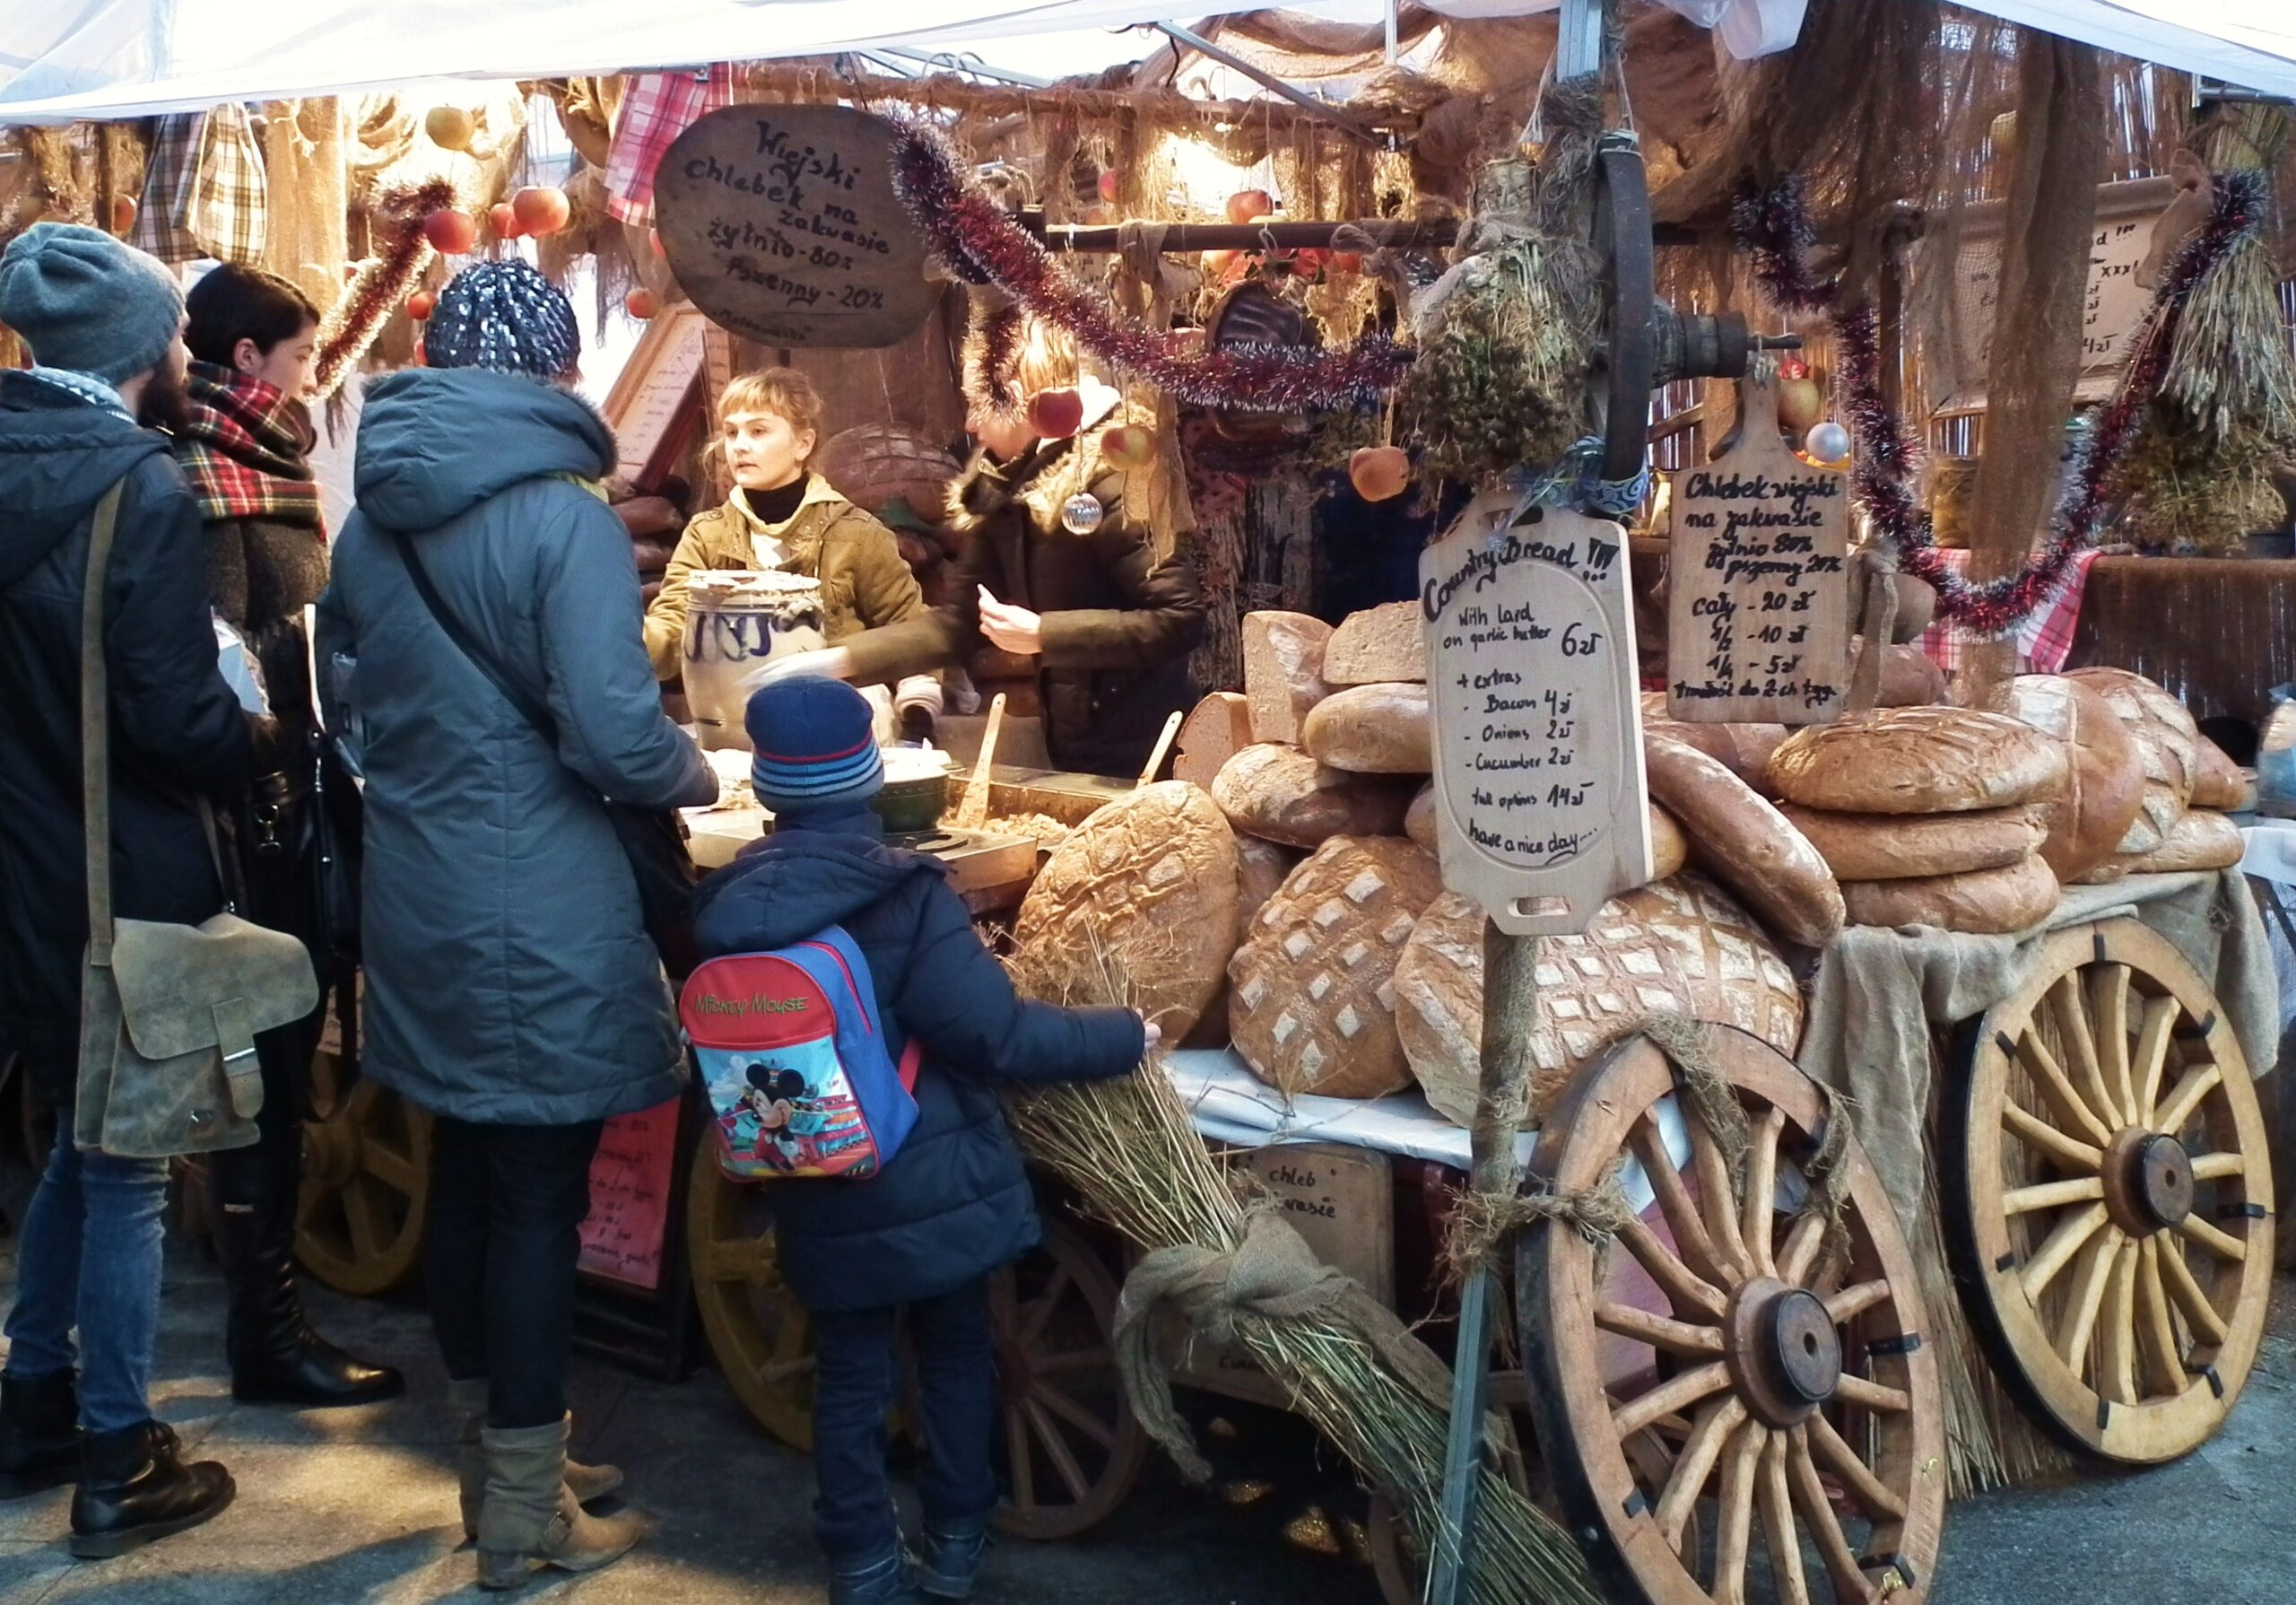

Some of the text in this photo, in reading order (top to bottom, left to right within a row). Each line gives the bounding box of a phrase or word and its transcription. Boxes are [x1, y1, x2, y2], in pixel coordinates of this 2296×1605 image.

[823, 203, 858, 225] na
[778, 209, 890, 255] zakwasie
[839, 284, 884, 310] 20%
[1685, 512, 1716, 528] na
[1423, 548, 1497, 624] Country
[1499, 536, 1578, 568] Bread
[1498, 602, 1535, 623] lard
[1443, 626, 1552, 652] on garlic butter
[1457, 668, 1522, 689] + extras
[1738, 679, 1761, 697] do
[1483, 693, 1536, 714] Bacon
[1482, 725, 1530, 742] Onions
[1475, 753, 1542, 772] Cucumber
[1469, 818, 1501, 848] have
[1505, 840, 1516, 852] a
[1518, 836, 1544, 853] nice
[1269, 1167, 1317, 1188] chleb
